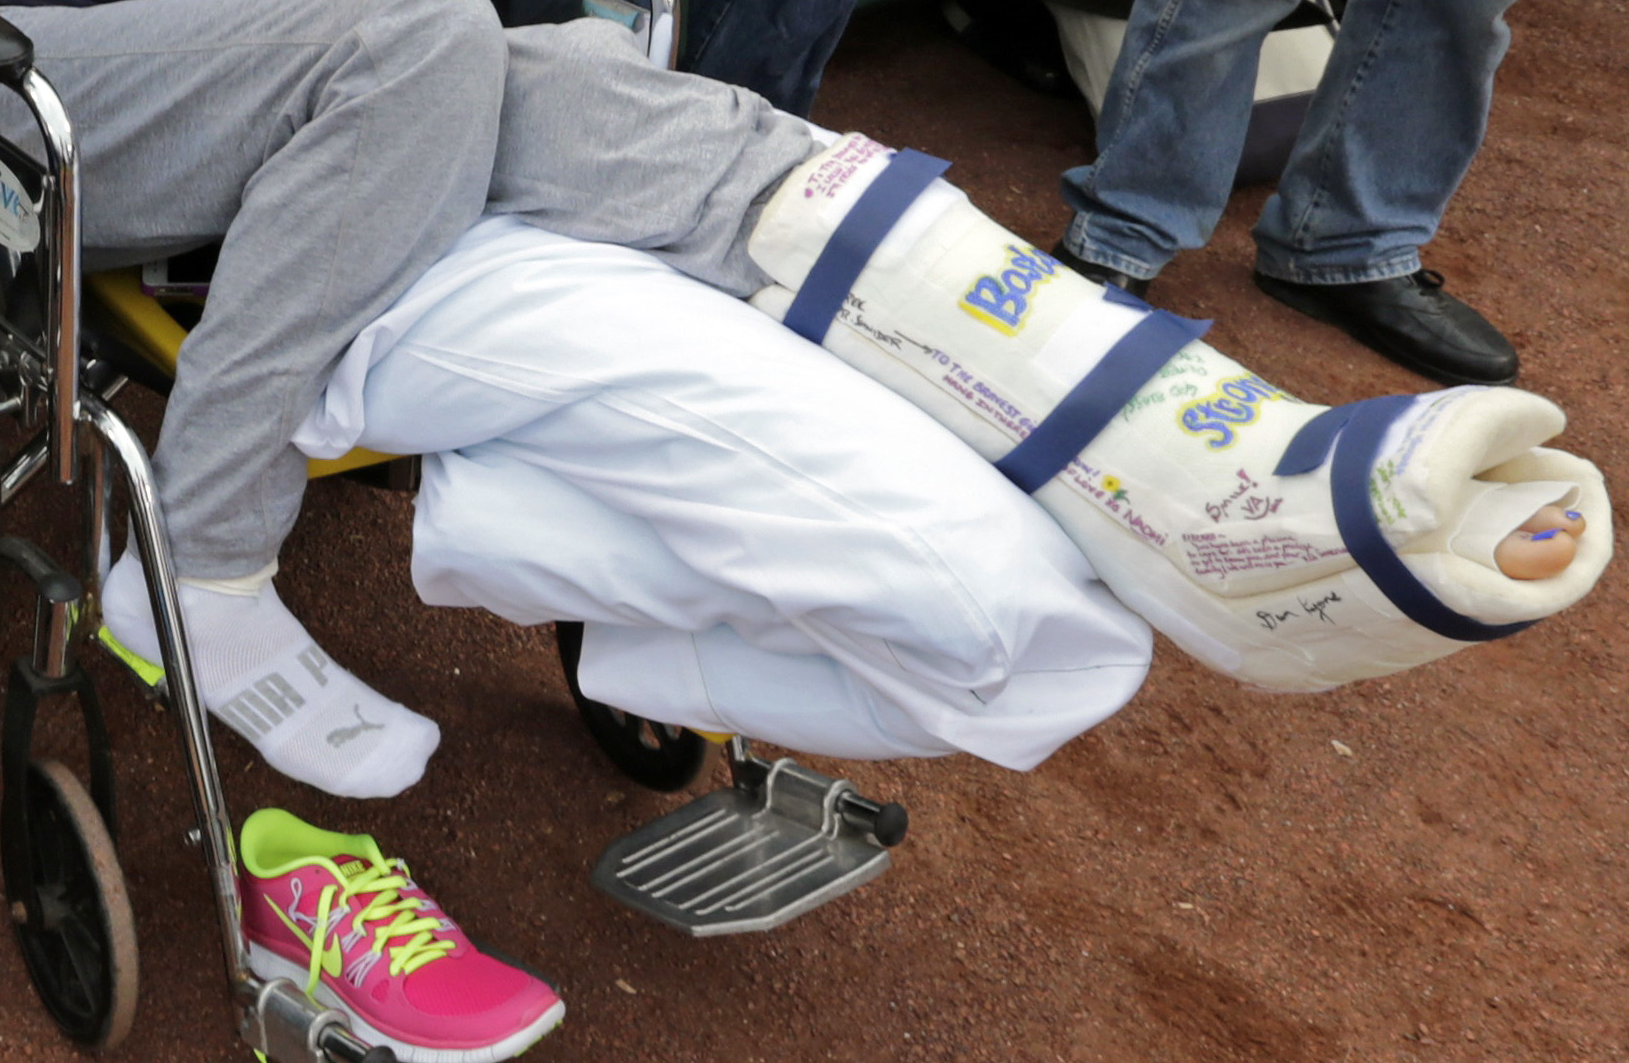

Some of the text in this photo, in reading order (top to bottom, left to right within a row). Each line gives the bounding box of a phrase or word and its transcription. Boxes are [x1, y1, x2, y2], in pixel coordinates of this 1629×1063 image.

[932, 349, 950, 366] TO
[1183, 374, 1282, 449] Stron
[339, 859, 367, 877] NIKE
